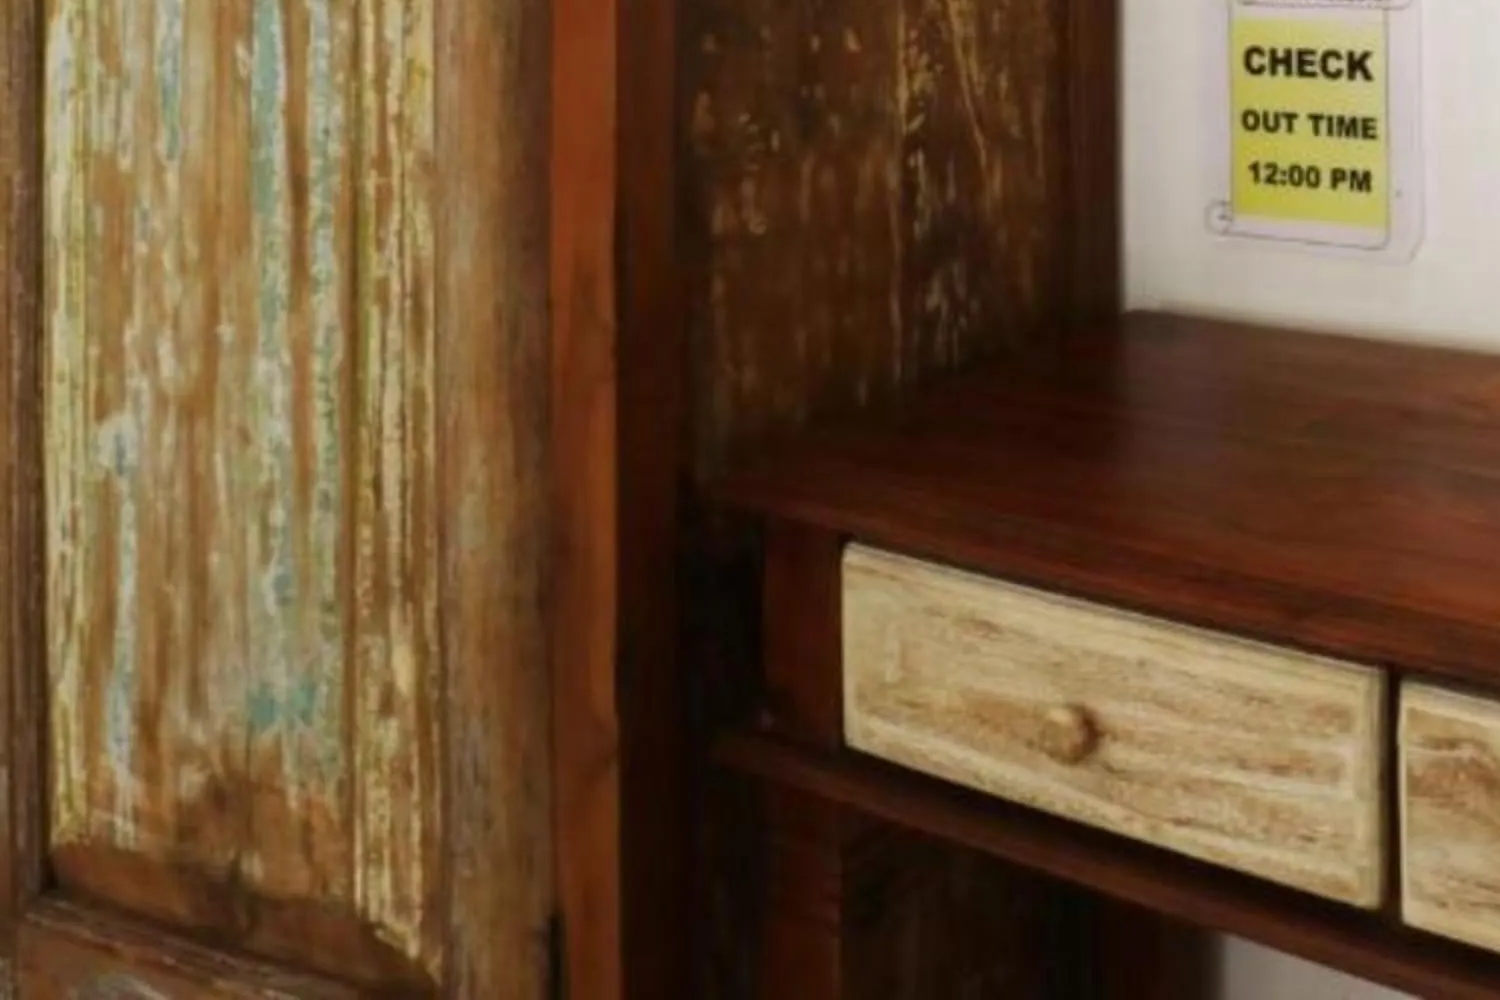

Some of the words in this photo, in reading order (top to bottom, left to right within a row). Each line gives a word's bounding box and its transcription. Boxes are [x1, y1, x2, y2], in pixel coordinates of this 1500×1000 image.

[1243, 46, 1374, 82] CHECK
[1241, 109, 1298, 134] OUT
[1308, 113, 1378, 140] TIME
[1248, 161, 1321, 189] 12:00
[1330, 168, 1373, 193] PM
